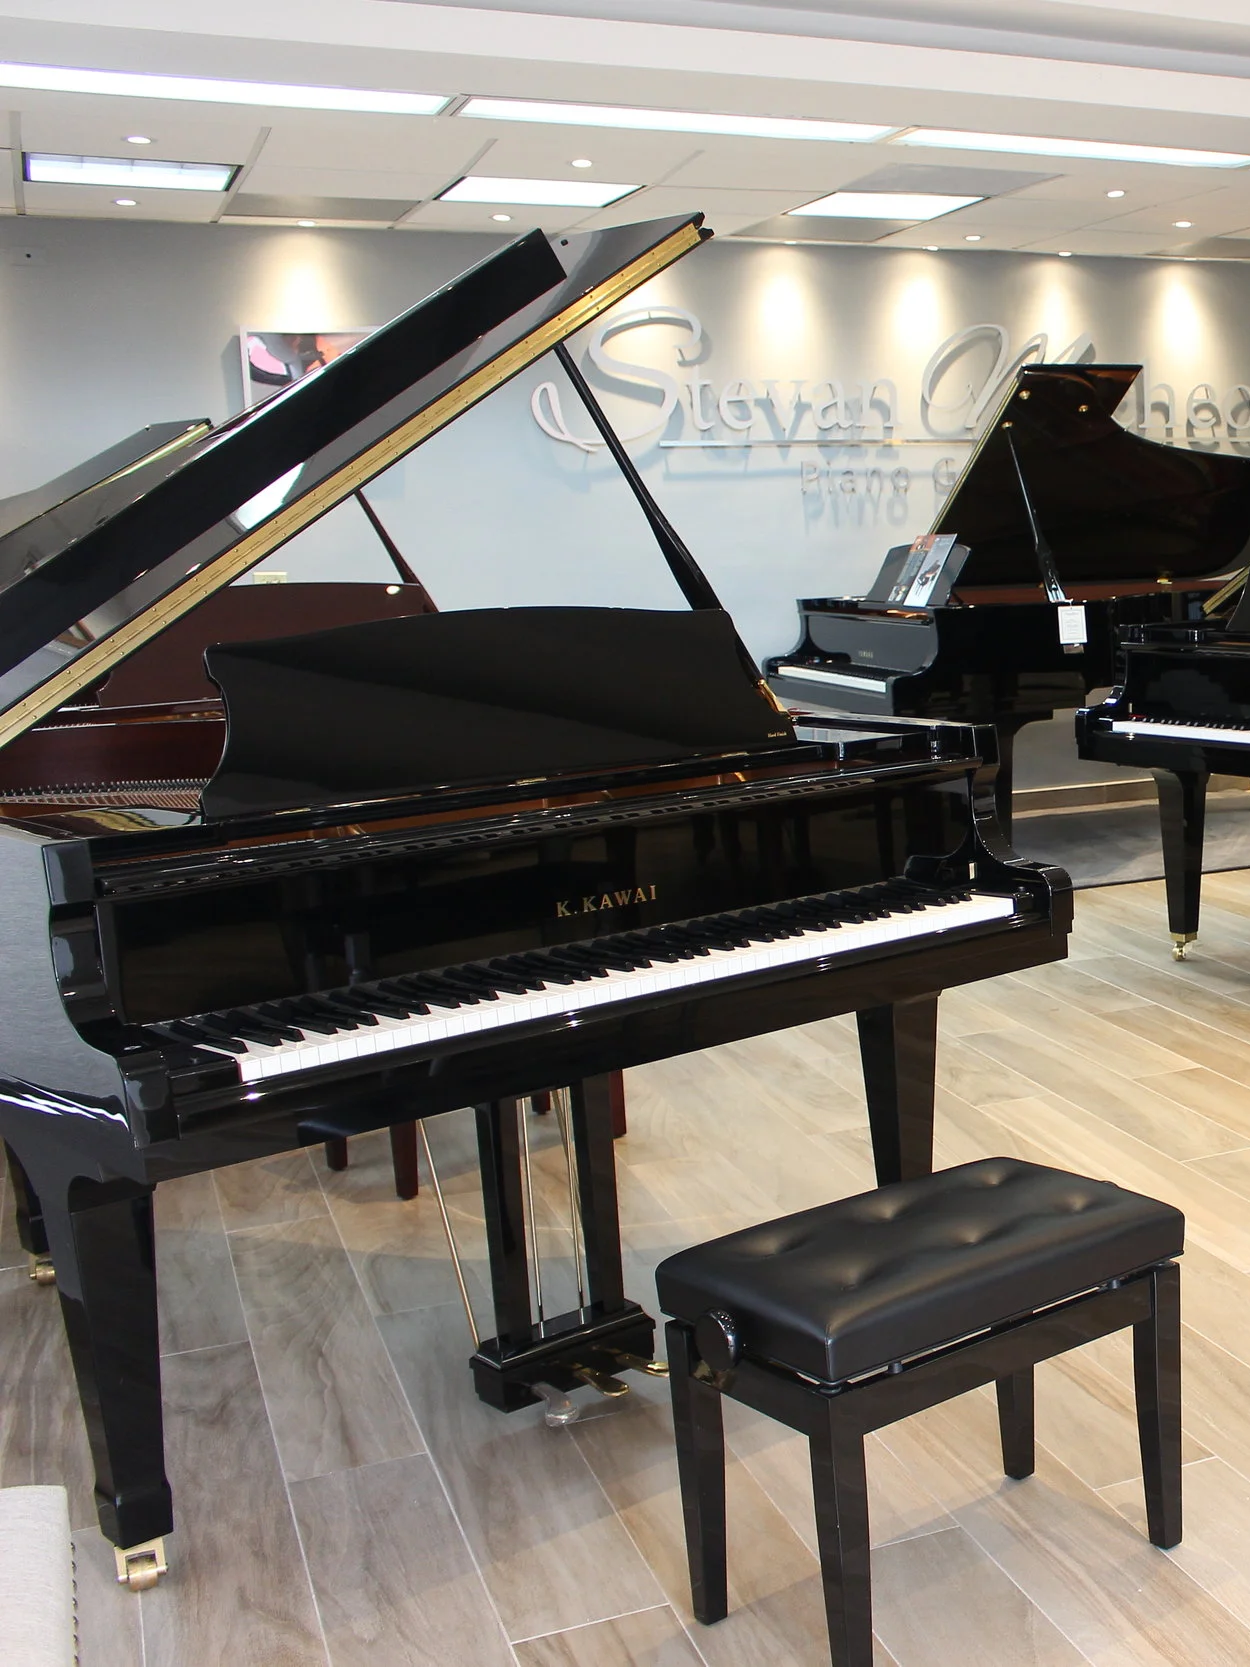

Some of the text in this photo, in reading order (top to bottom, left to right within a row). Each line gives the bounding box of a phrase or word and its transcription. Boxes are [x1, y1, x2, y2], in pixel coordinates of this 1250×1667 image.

[531, 305, 903, 453] Stevan
[800, 460, 911, 495] Piano
[582, 884, 657, 913] KAWAI
